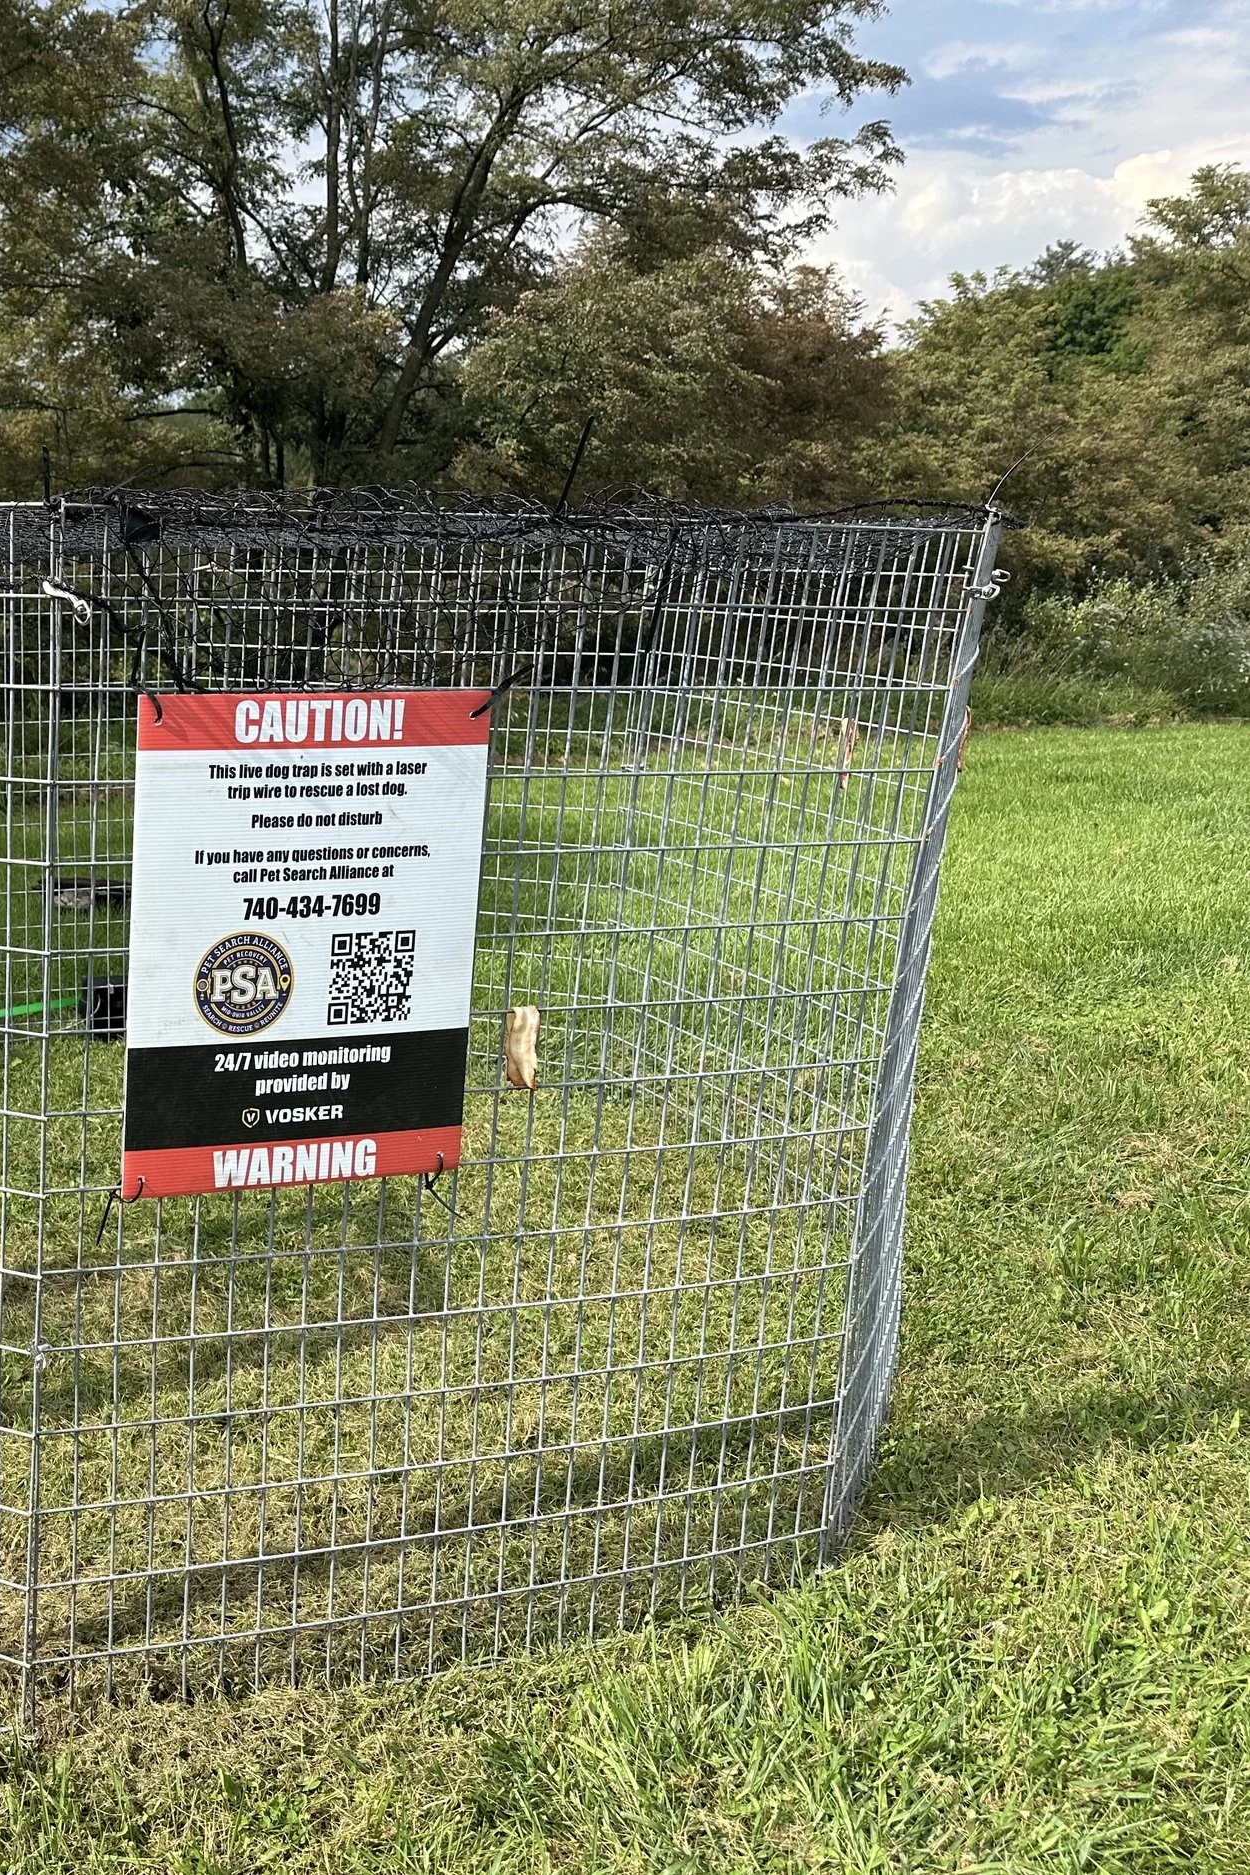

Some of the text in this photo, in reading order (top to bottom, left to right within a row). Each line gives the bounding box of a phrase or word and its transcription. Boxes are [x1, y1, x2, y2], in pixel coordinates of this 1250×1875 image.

[235, 699, 405, 743] CAUTION!
[209, 762, 427, 779] This live dog trap is set with a laser
[228, 782, 407, 800] trip wire to rescue a lost dog.
[252, 812, 382, 828] Please do not disturb
[195, 844, 430, 866] If you have any questions or concerns,
[233, 864, 394, 883] call Pet Search Alliance at
[243, 892, 381, 920] 740-434-7699
[201, 936, 288, 973] PET SEARCH ALLIANCE
[223, 951, 267, 965] PET RECOVERY
[211, 964, 278, 1004] PSA
[203, 1002, 283, 1032] SEARCH RESCUE REUNITE
[246, 1004, 265, 1018] VALLEY
[214, 1045, 391, 1072] 24/7 video monitoring
[255, 1073, 350, 1096] provided by
[265, 1104, 343, 1124] VOSKER
[213, 1138, 376, 1188] WARNING
